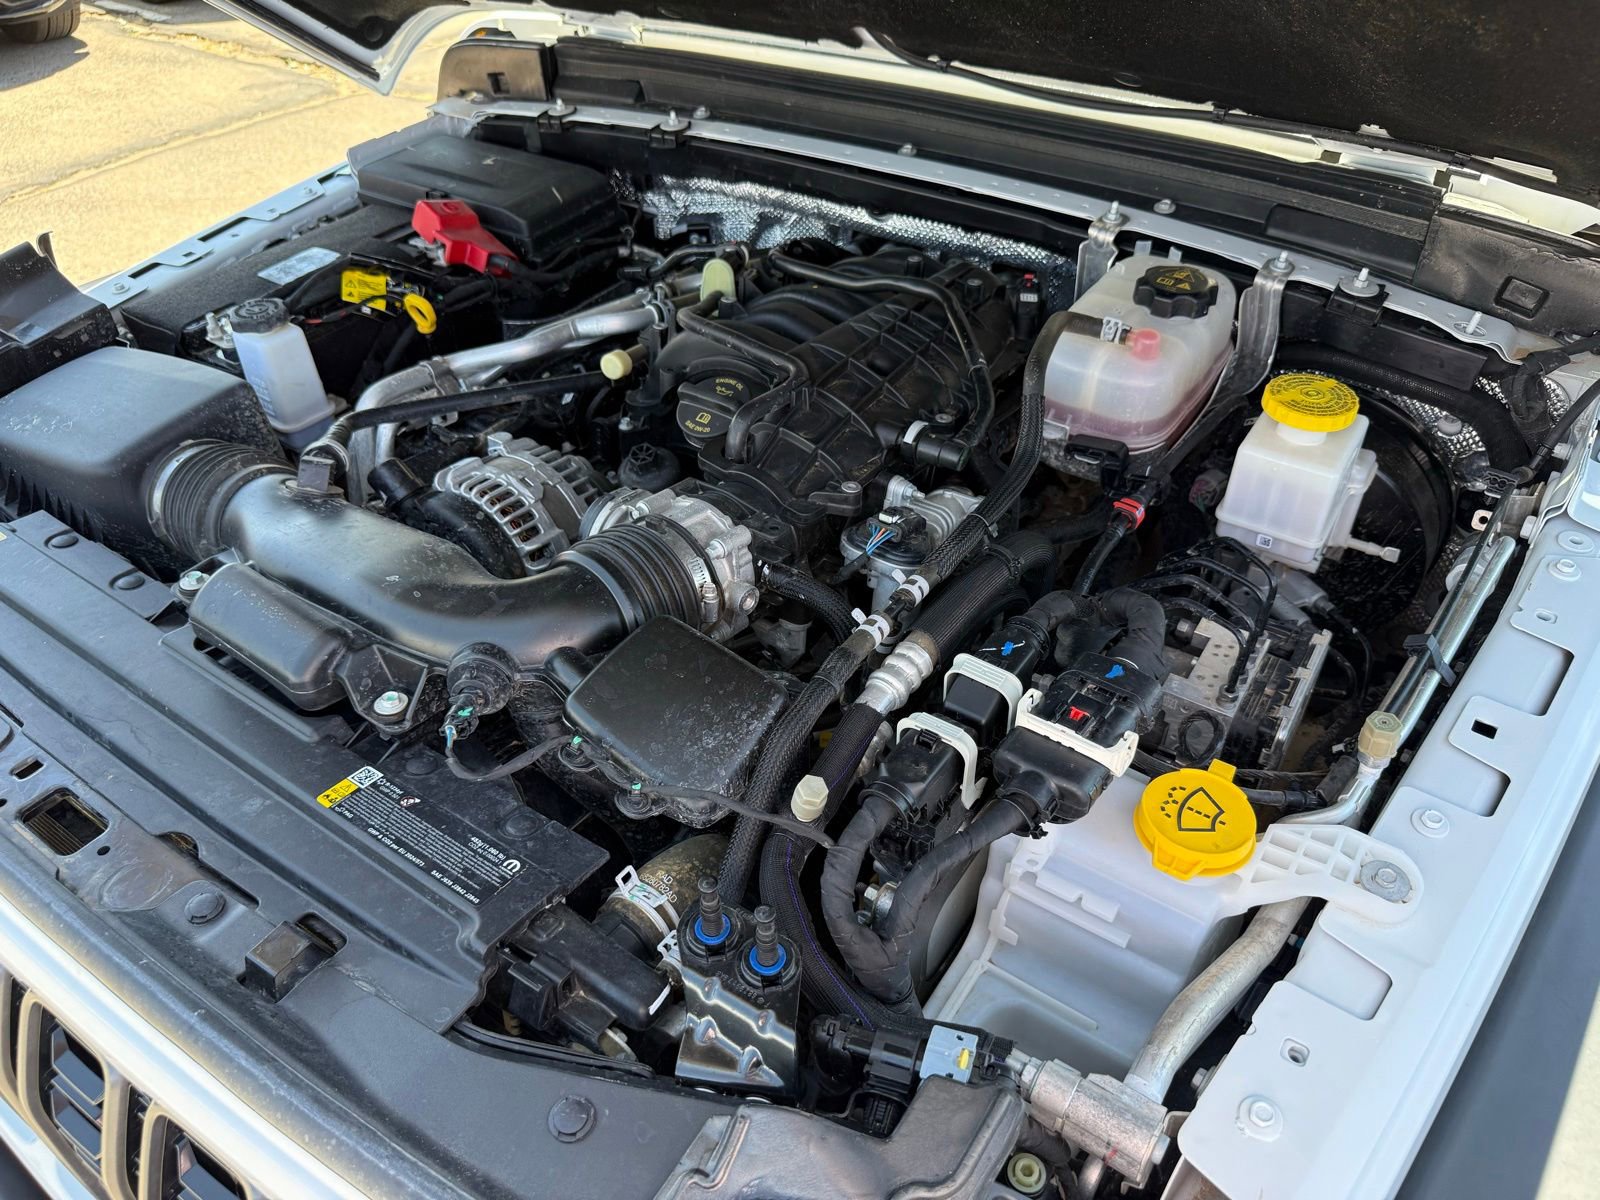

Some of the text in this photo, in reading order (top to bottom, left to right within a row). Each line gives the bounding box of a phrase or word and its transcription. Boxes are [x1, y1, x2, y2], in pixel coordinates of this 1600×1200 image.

[685, 420, 711, 433] SAE 0W-20
[367, 827, 380, 835] GWP
[381, 837, 393, 845] CO2
[431, 870, 443, 879] SAE
[655, 870, 673, 884] RAD
